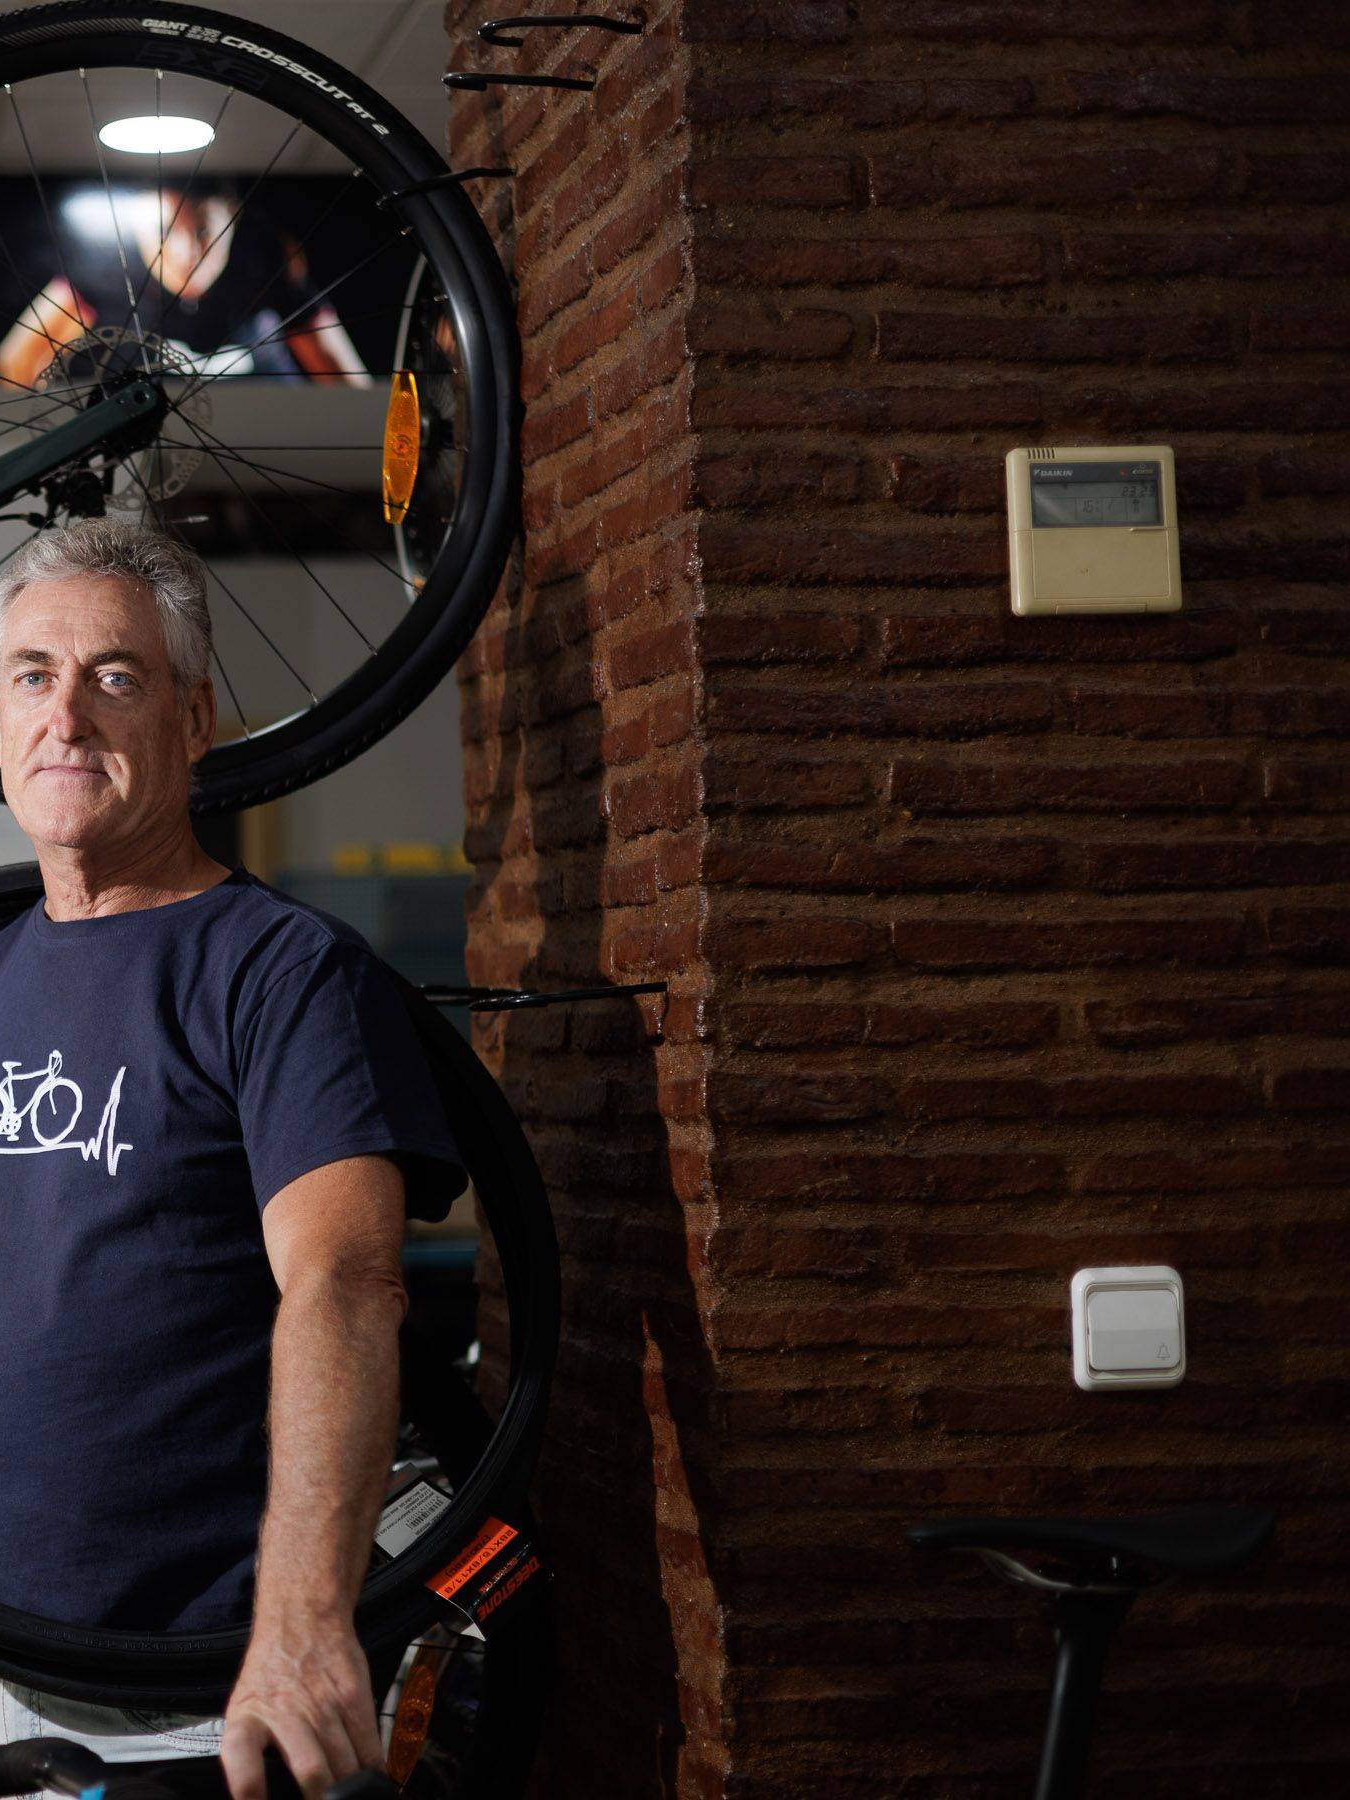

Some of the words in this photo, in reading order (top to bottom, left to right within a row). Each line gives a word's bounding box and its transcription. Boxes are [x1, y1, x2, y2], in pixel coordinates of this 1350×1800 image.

[142, 18, 190, 31] GIANT
[220, 35, 354, 100] CROSSCUT
[346, 102, 376, 119] AT
[1040, 469, 1074, 477] DAIKIN
[476, 1555, 540, 1623] DEESTONE
